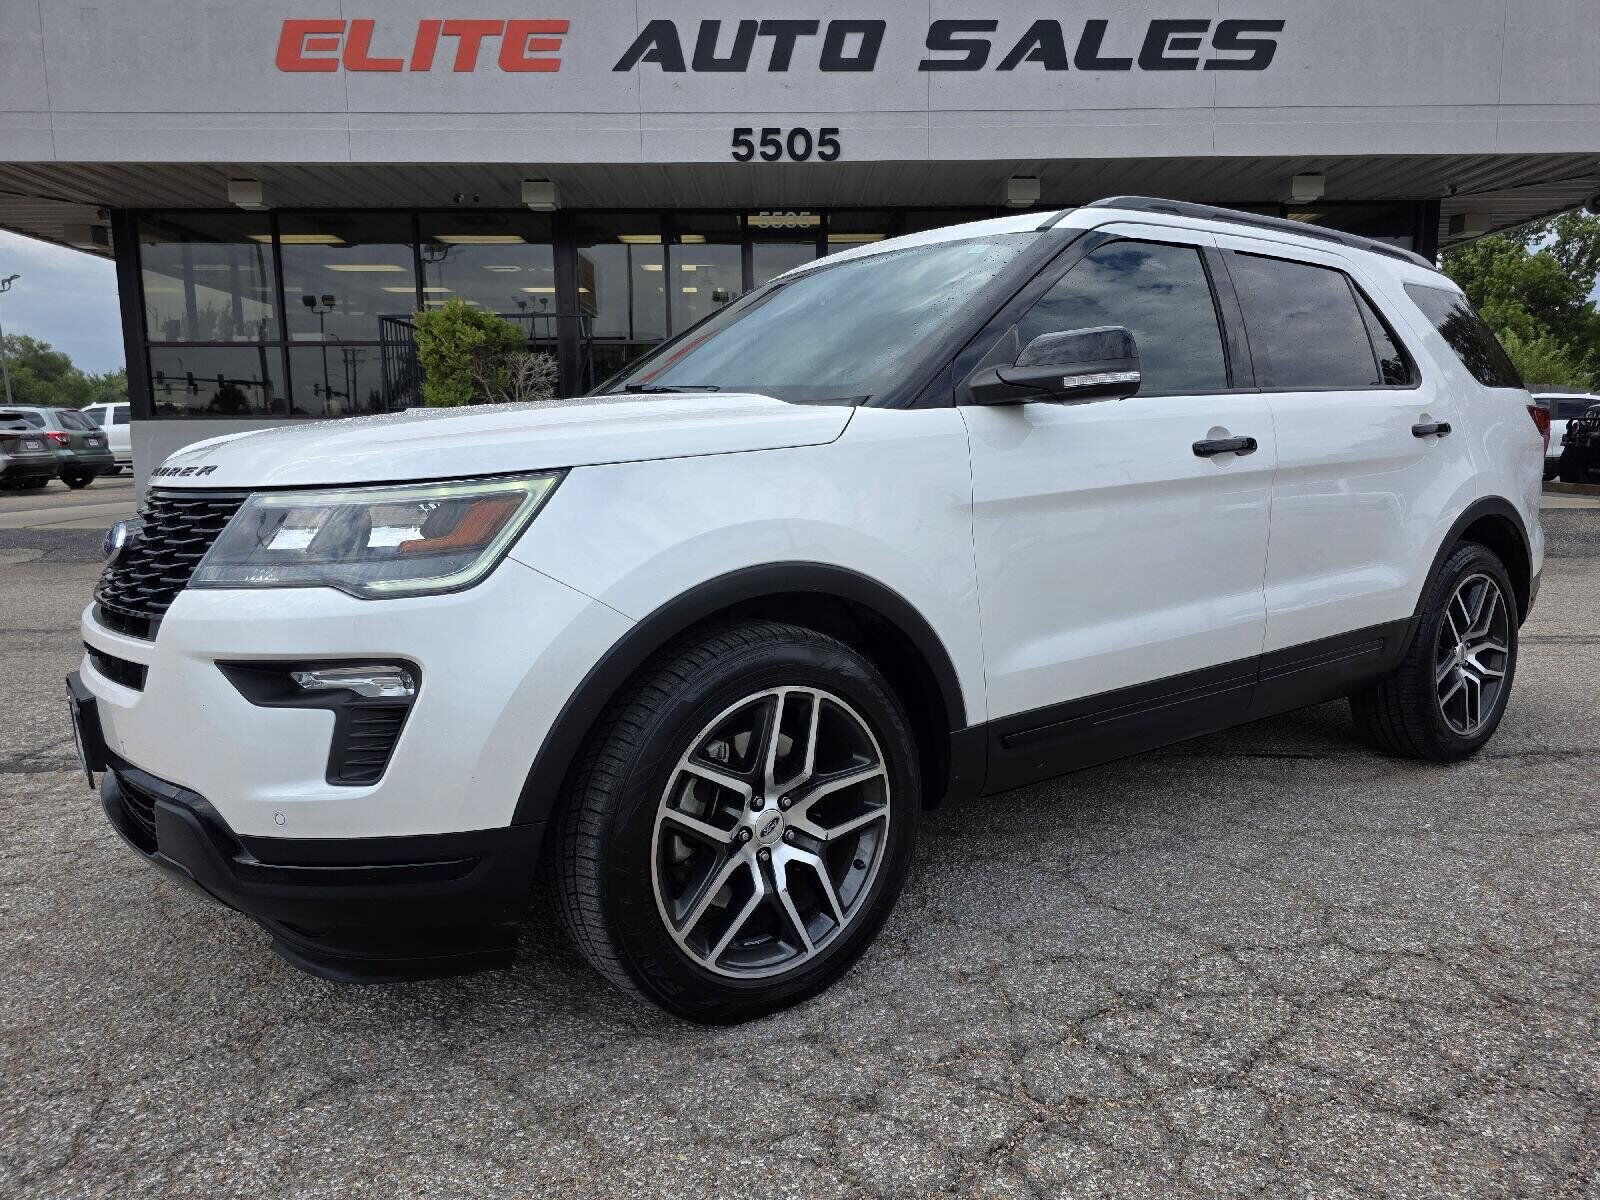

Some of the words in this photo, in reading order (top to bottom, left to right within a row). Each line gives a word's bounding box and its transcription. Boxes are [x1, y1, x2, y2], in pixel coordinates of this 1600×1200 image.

[276, 20, 568, 72] ELITE
[612, 20, 886, 72] AUTO
[918, 19, 1285, 71] SALES
[732, 127, 841, 162] 5505
